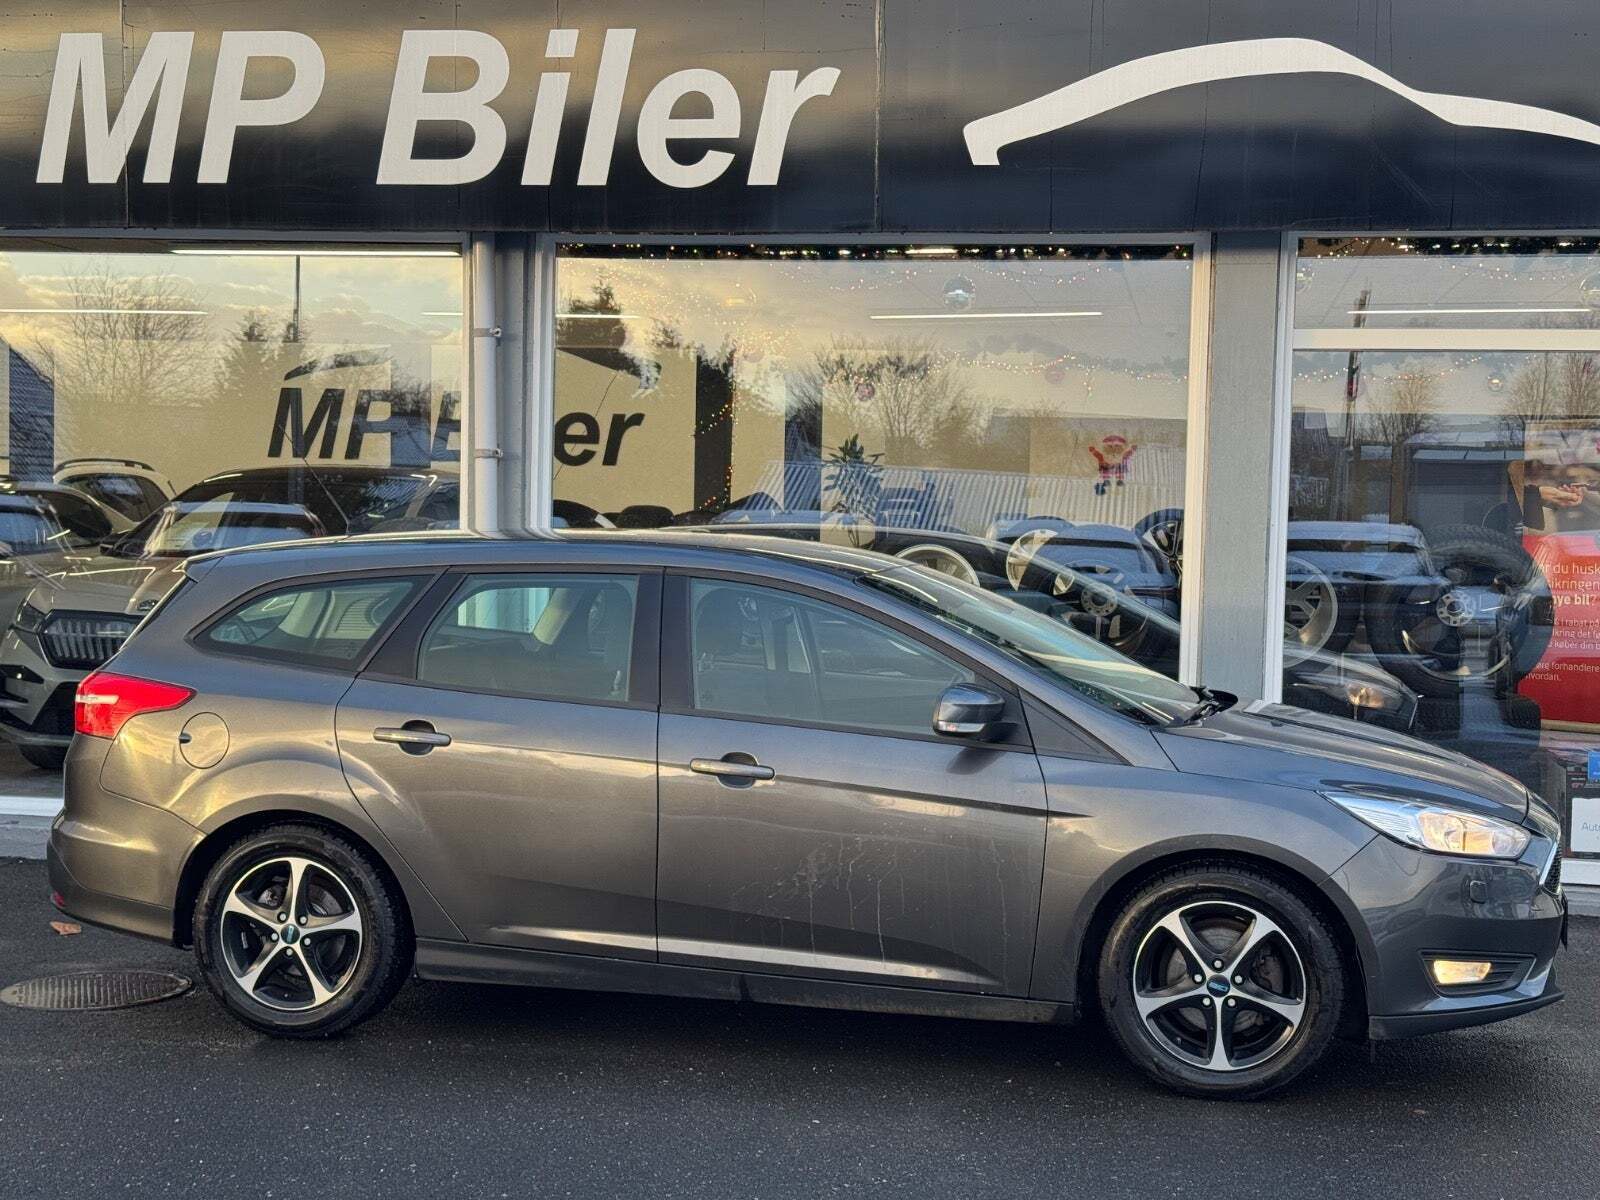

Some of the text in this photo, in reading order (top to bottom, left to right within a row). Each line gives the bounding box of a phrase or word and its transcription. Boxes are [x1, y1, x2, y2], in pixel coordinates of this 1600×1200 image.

[37, 28, 841, 188] MP Biler
[1553, 562, 1569, 574] du
